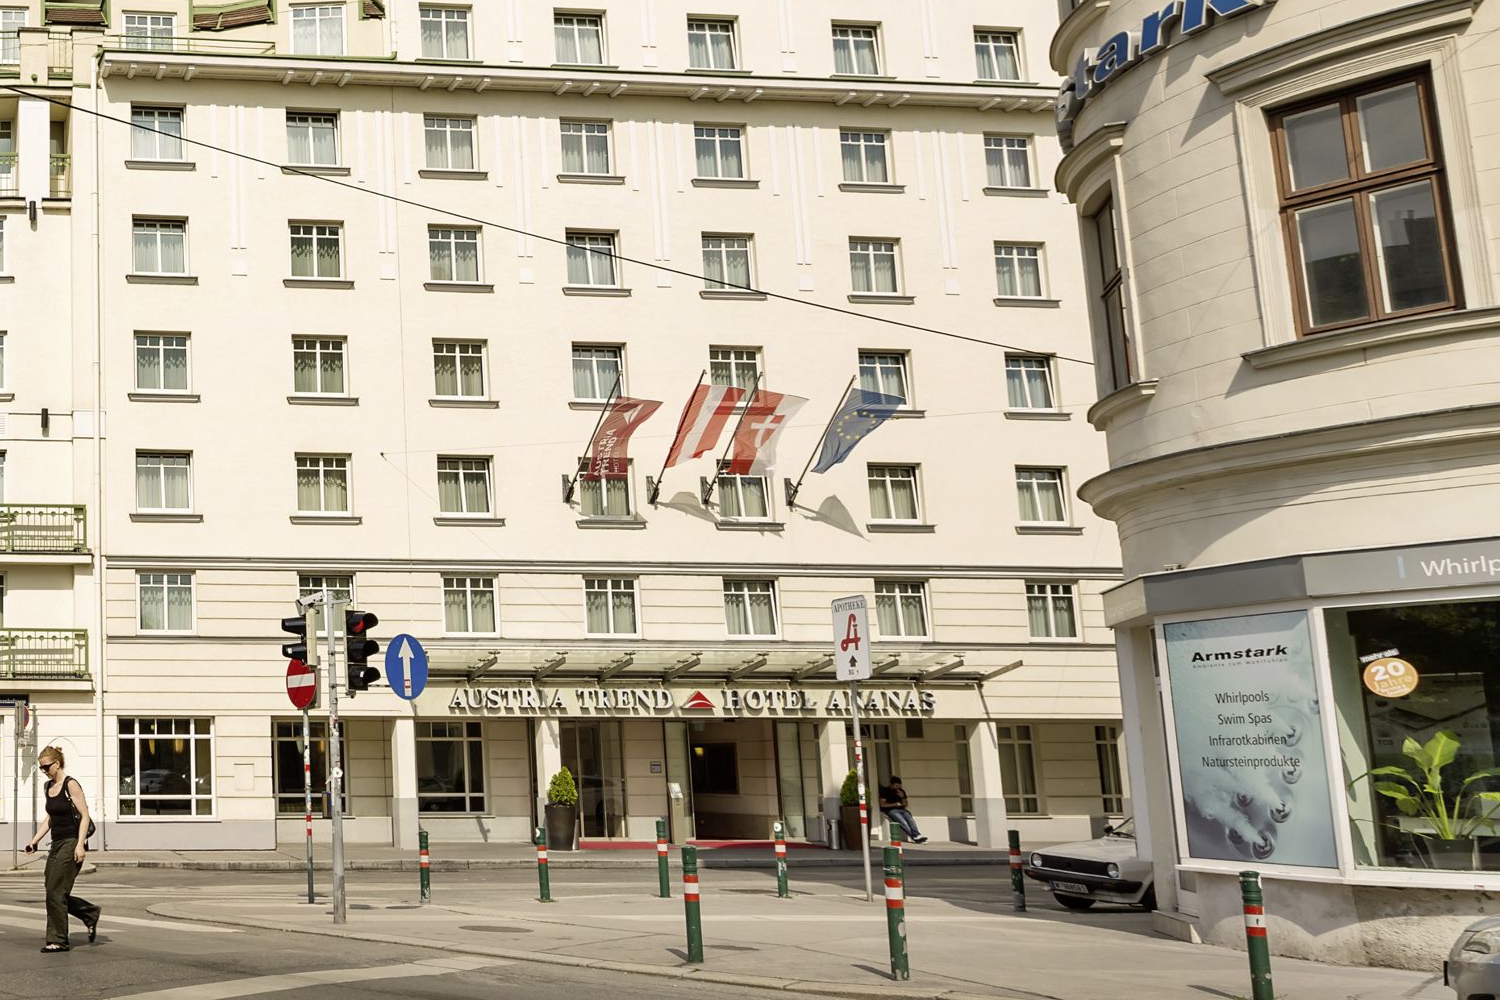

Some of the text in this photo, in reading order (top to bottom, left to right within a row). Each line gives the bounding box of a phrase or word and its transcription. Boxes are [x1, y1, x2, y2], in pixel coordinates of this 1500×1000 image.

[600, 437, 617, 476] TREND
[833, 599, 865, 613] APOTHEKE
[1191, 644, 1288, 663] Armstark
[1371, 661, 1406, 681] 20
[449, 688, 936, 711] AUSTRIA TREND HOTEL ANANAS
[1214, 690, 1270, 706] Whirlpools
[1217, 712, 1273, 726] Swim Spas
[1208, 733, 1288, 747] Infrarotkabinen
[1202, 755, 1301, 770] Natursteinprodukte
